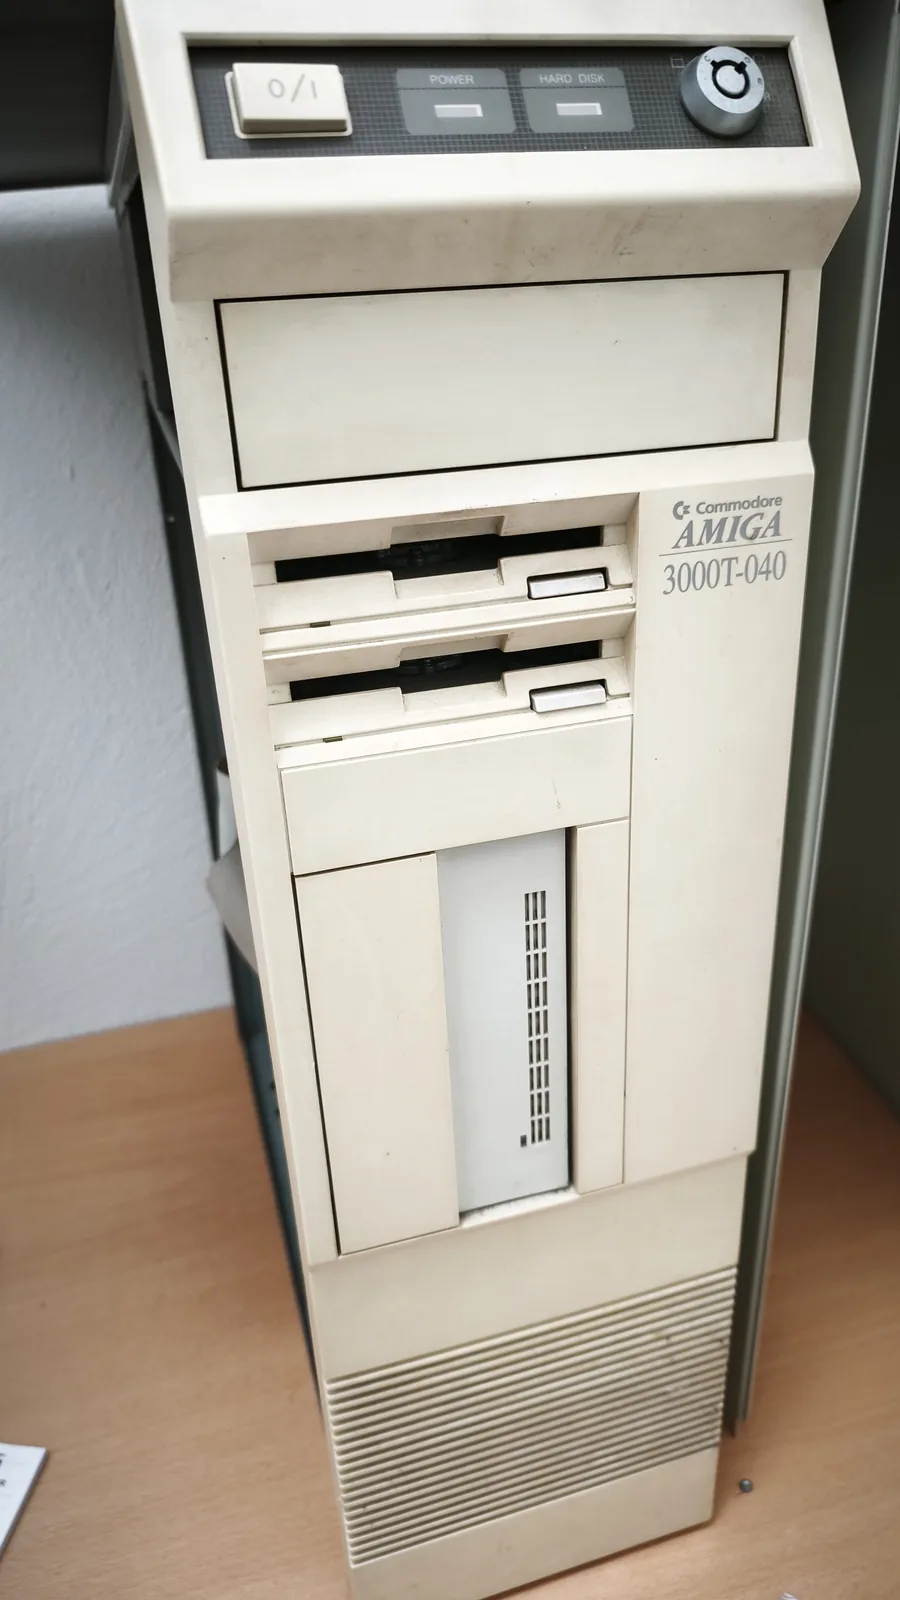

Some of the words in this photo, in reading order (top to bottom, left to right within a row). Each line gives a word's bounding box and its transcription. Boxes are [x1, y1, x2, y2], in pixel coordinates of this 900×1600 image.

[429, 74, 475, 85] POWER
[539, 74, 573, 84] HARD
[578, 73, 605, 84] DISK
[696, 495, 783, 515] Commodore
[671, 510, 782, 549] AMIGA
[662, 550, 787, 595] 3000T-040
